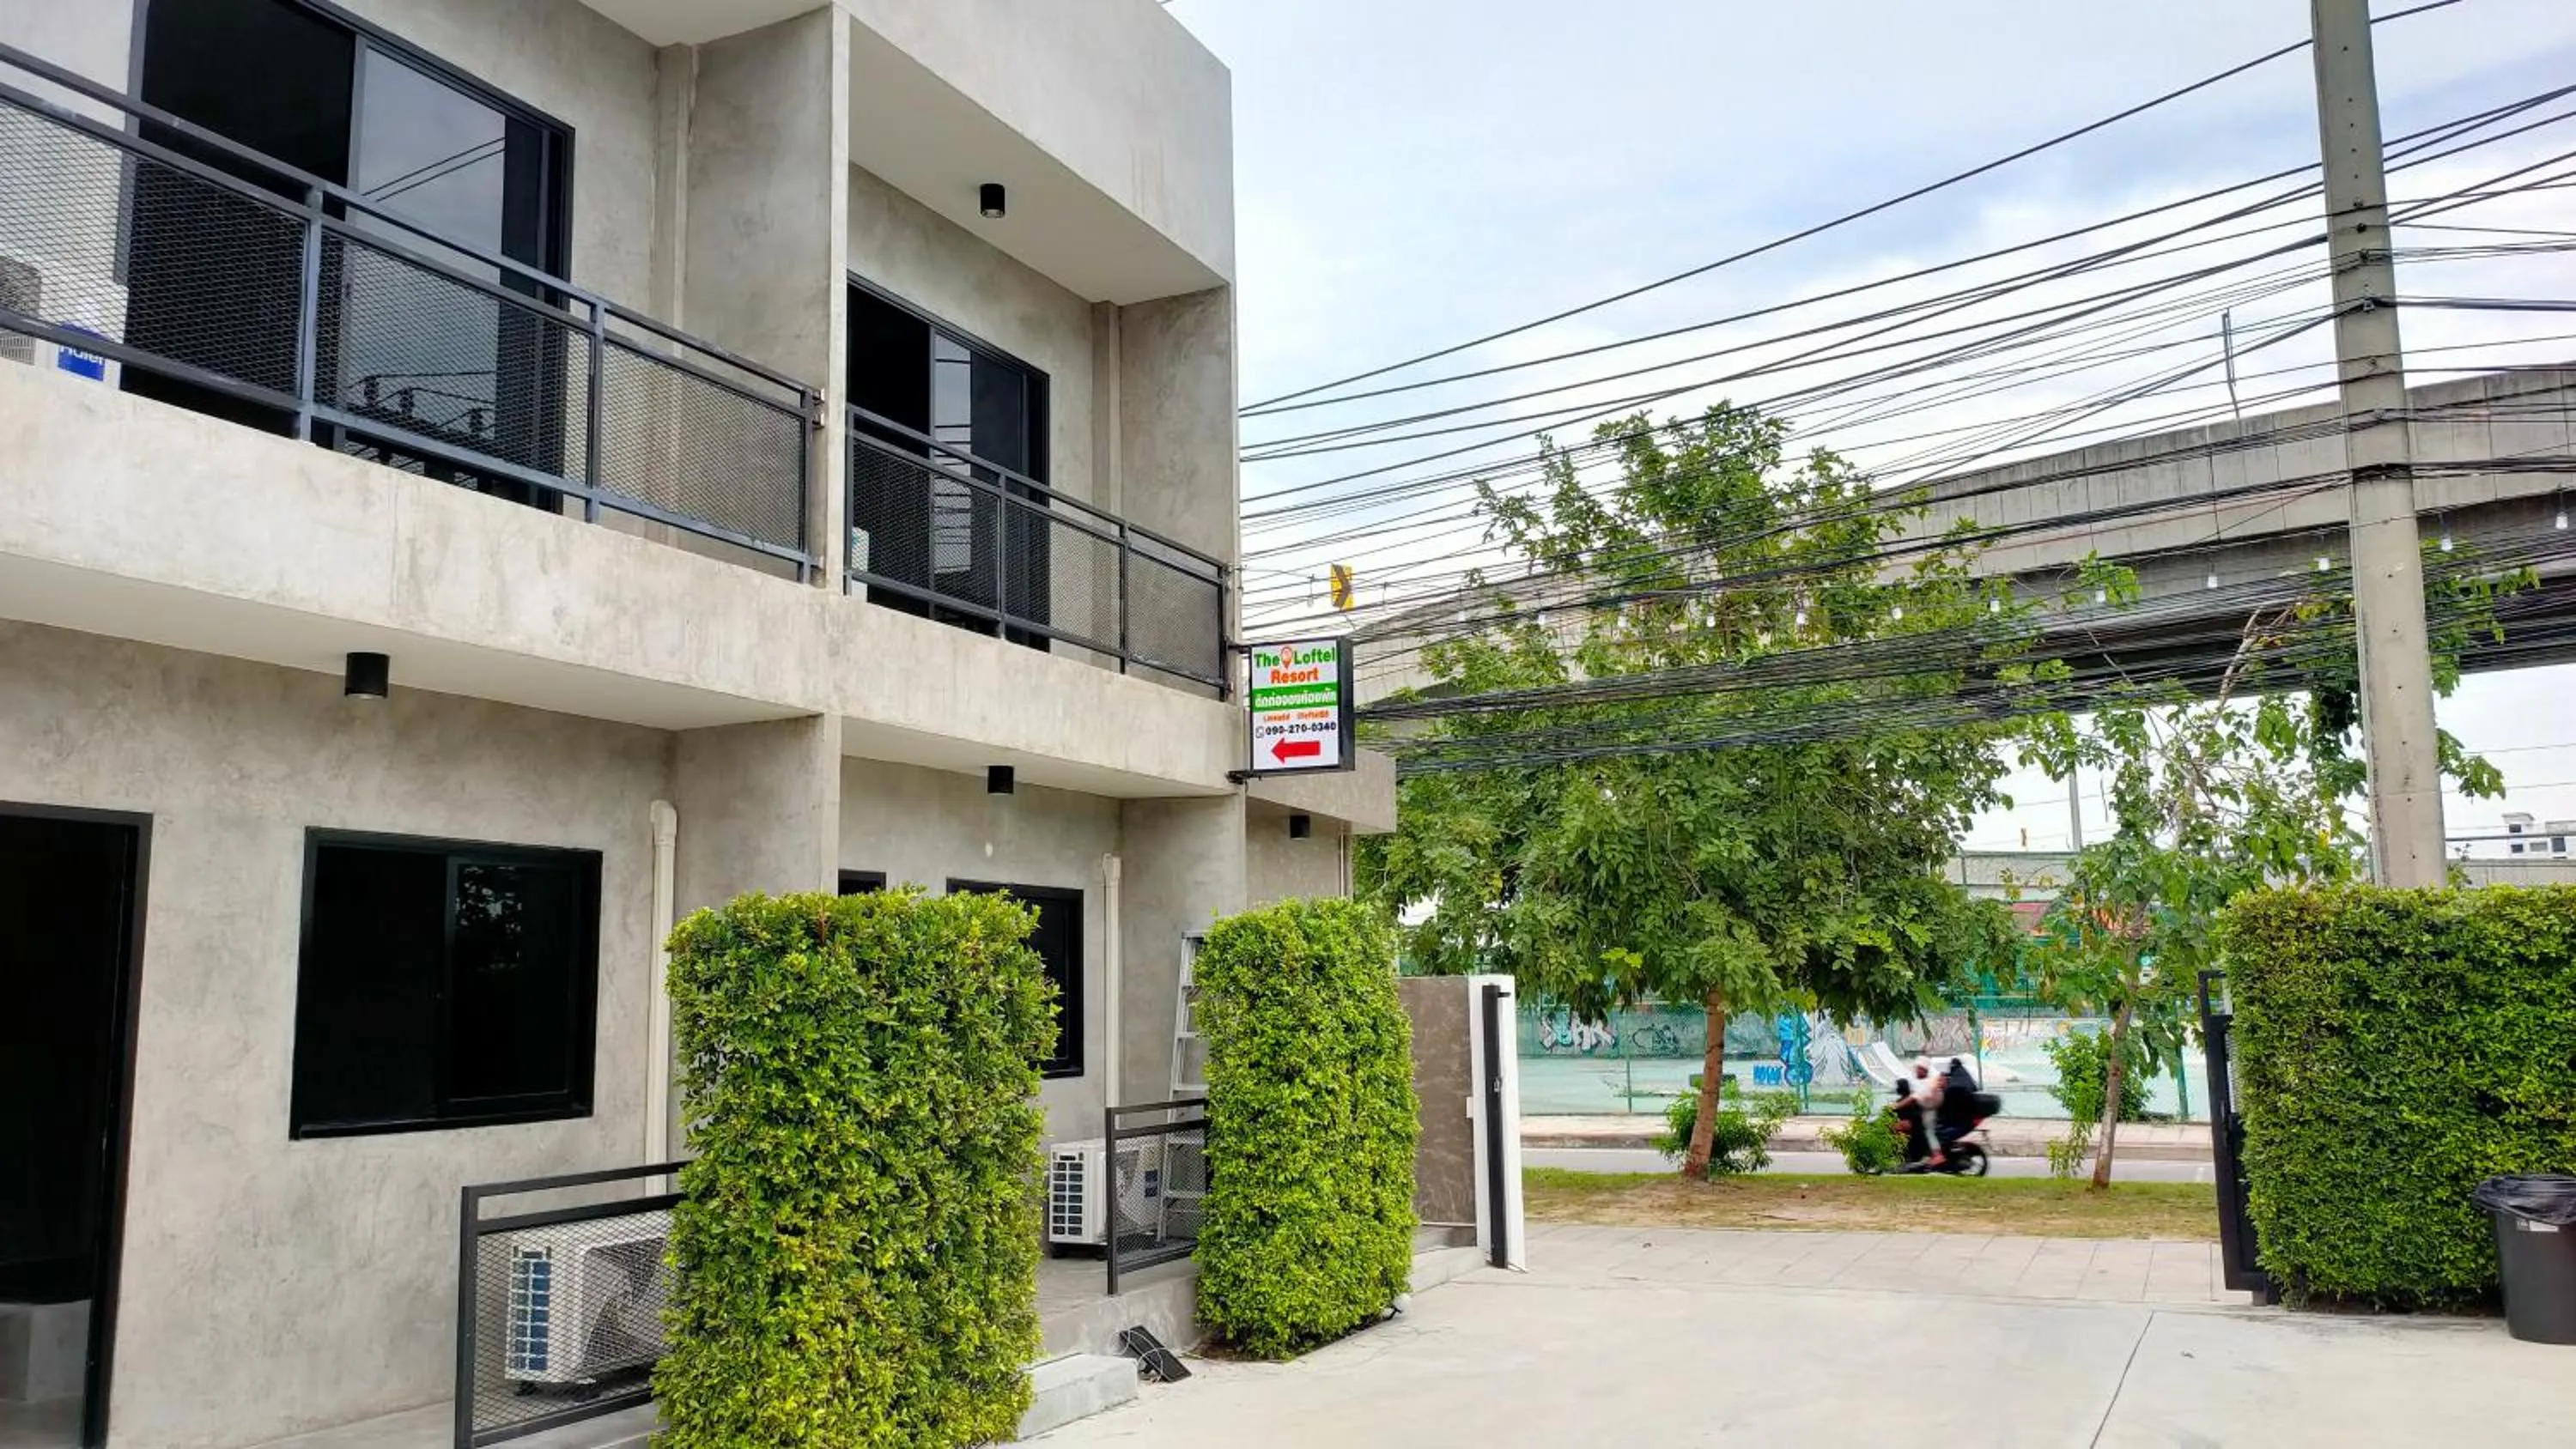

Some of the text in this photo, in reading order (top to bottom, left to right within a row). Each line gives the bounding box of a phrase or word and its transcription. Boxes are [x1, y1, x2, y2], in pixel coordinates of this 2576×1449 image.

[1254, 647, 1335, 668] The Loftel
[1270, 667, 1319, 683] Resort
